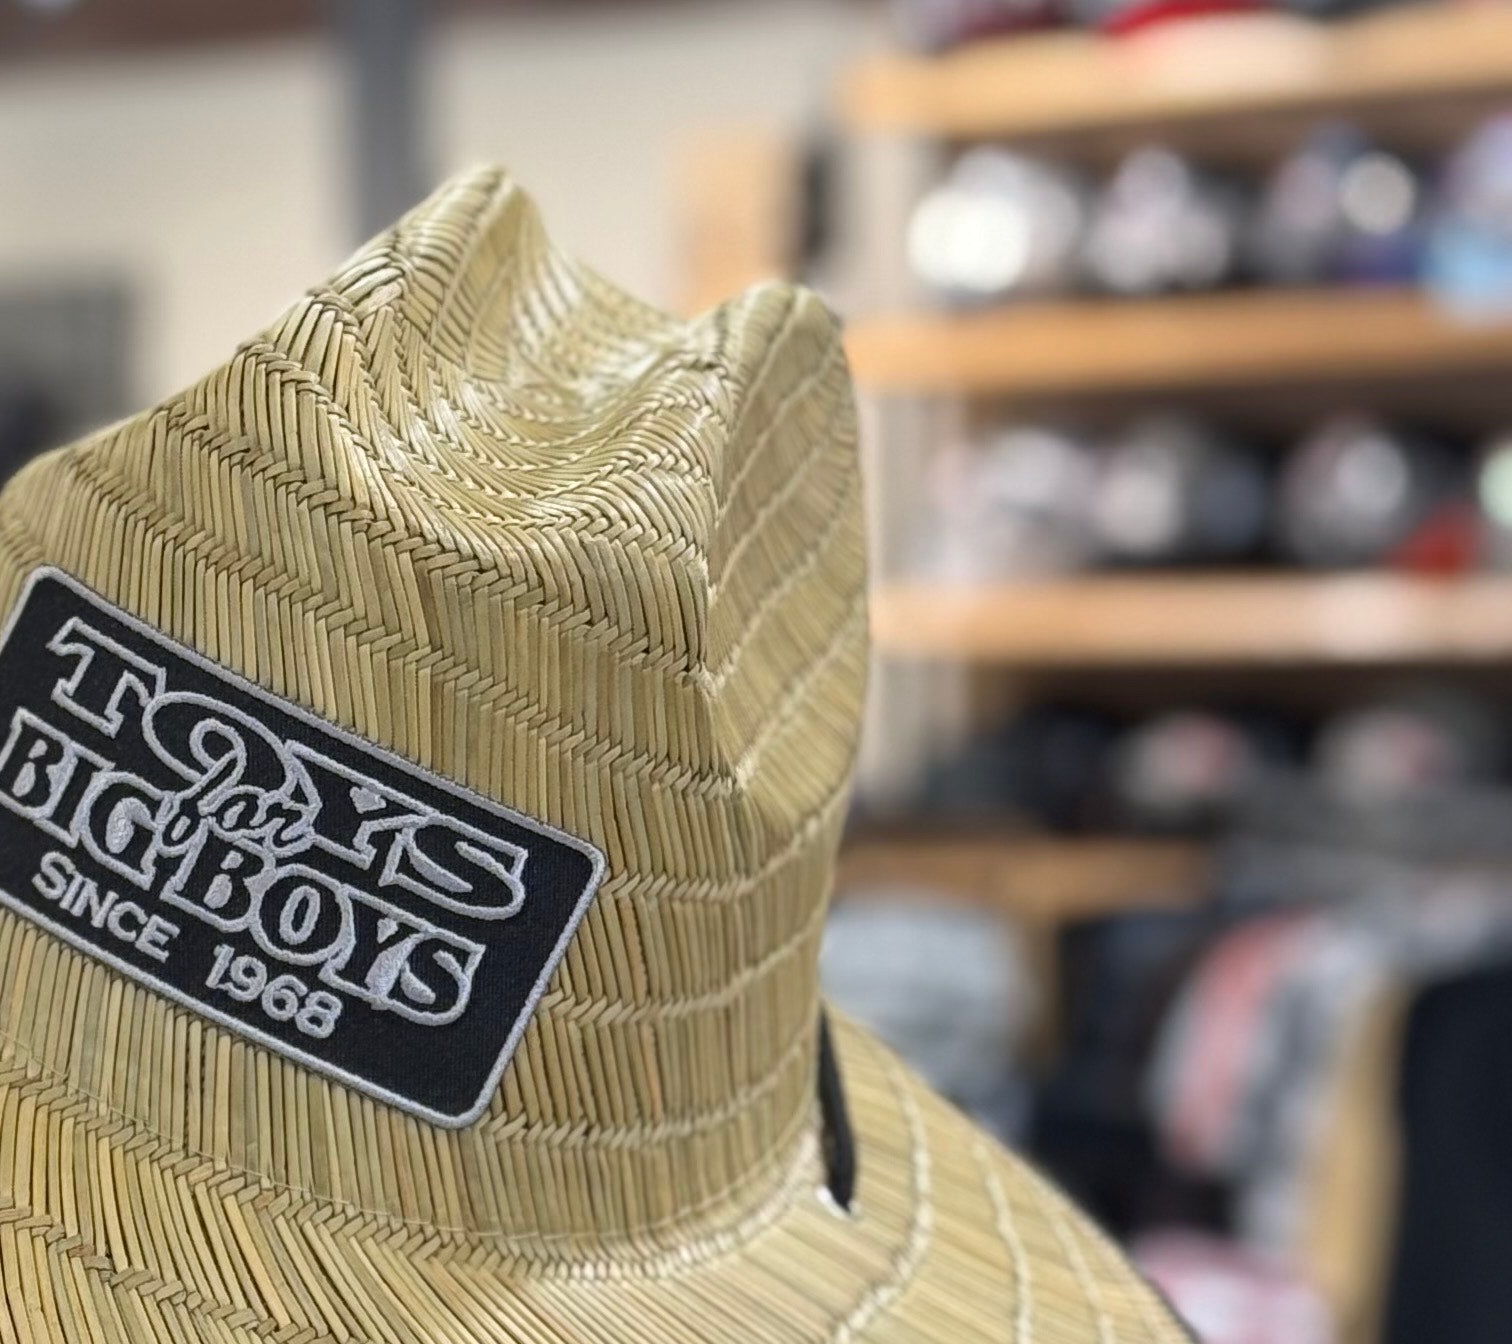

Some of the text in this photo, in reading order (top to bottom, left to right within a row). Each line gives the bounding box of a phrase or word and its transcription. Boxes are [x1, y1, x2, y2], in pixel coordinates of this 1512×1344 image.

[46, 615, 529, 921] TOYS
[154, 718, 321, 857] for
[31, 851, 343, 1039] SINCE 1968
[159, 818, 486, 1026] BOYS
